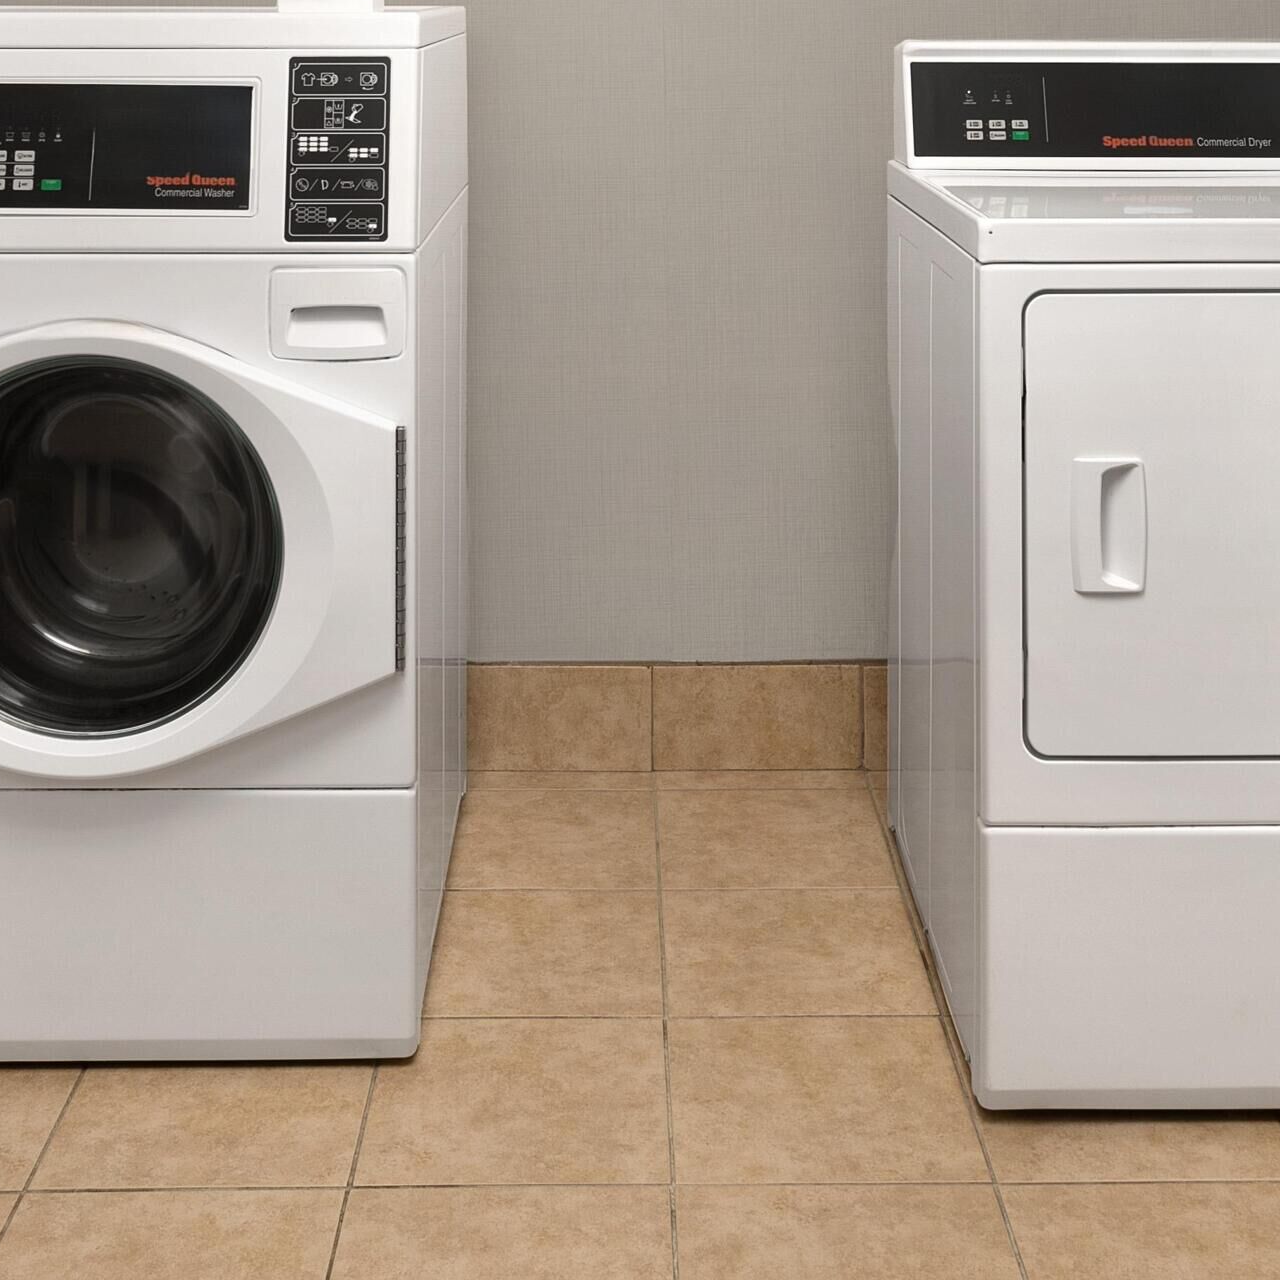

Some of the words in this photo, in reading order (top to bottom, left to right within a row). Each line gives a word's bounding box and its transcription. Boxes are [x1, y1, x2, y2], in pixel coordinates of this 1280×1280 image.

[1102, 135, 1147, 148] Speed
[1148, 136, 1193, 147] Queen
[1197, 137, 1246, 147] Commercial
[1248, 137, 1271, 149] Dryer
[192, 174, 235, 186] Queen
[154, 187, 203, 197] Commercial
[204, 188, 235, 198] Washer
